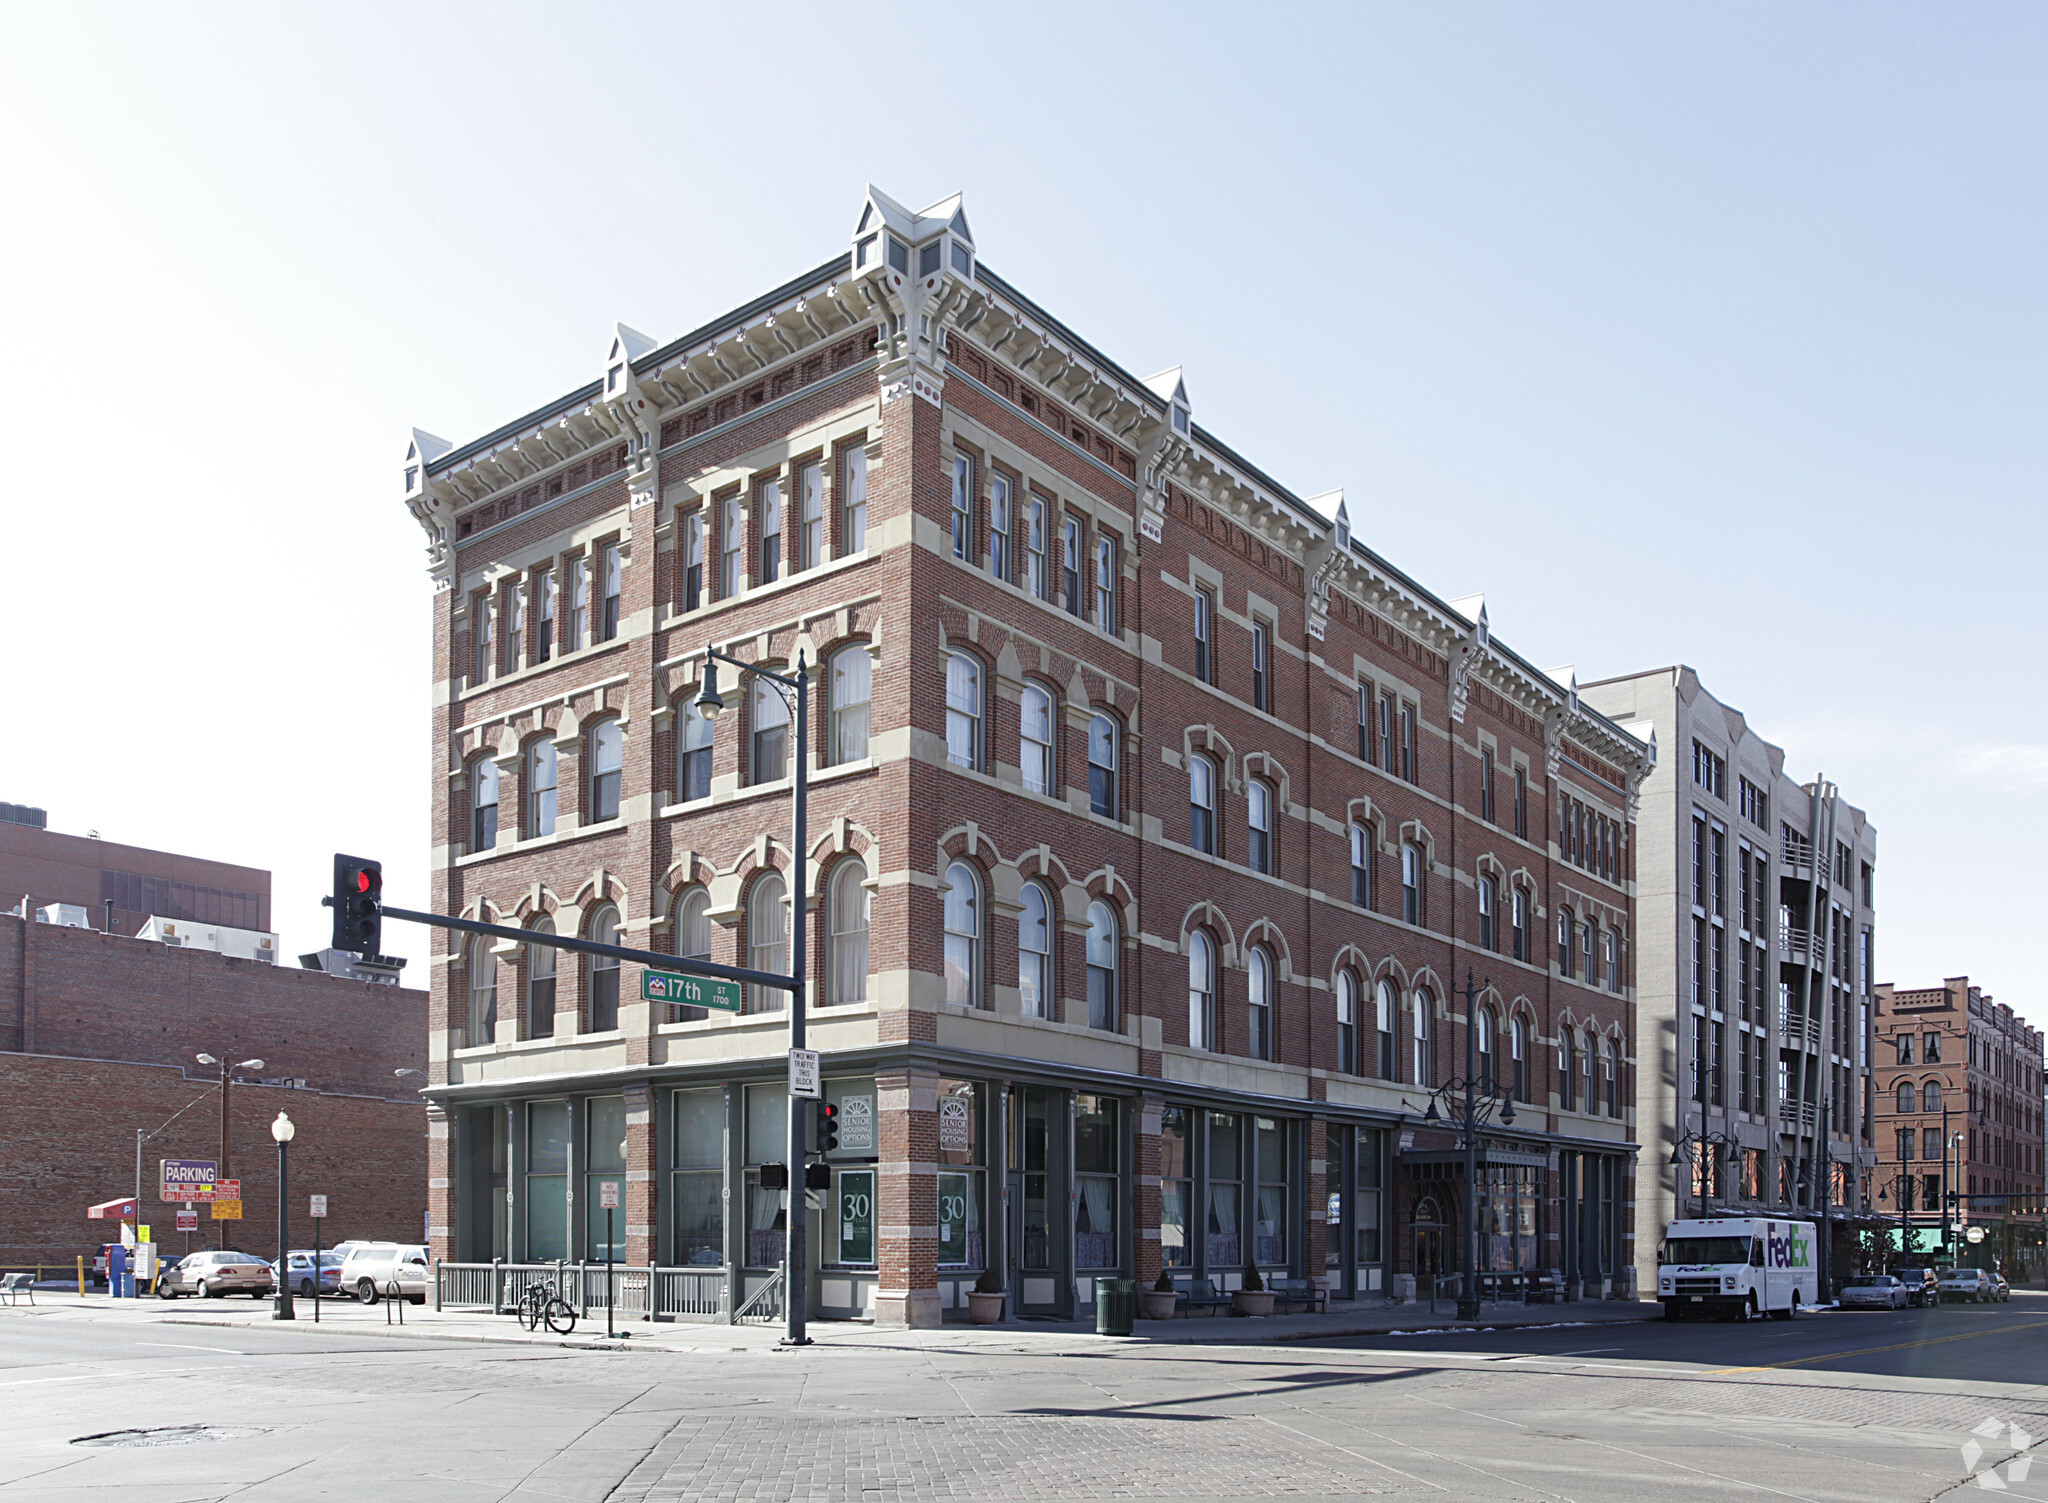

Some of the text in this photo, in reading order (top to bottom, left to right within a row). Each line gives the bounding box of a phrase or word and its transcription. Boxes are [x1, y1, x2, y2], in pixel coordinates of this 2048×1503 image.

[667, 978, 726, 1001] 17th ST
[712, 995, 730, 1005] 1700
[794, 1060, 815, 1069] TRAFFIC
[799, 1069, 810, 1077] THIS
[796, 1077, 813, 1086] BLOCK
[843, 1117, 871, 1126] SENIOR
[941, 1118, 967, 1128] SENIOR
[843, 1125, 871, 1133] HOUSING
[941, 1127, 967, 1136] HOUSING
[843, 1133, 871, 1142] OPTIONS
[941, 1135, 967, 1143] OPTIONS
[166, 1166, 215, 1182] PARKING
[124, 1205, 132, 1214] P
[844, 1194, 870, 1221] 30
[941, 1195, 965, 1222] 30
[1767, 1222, 1809, 1268] FedEx
[1676, 1265, 1723, 1273] FedEx
